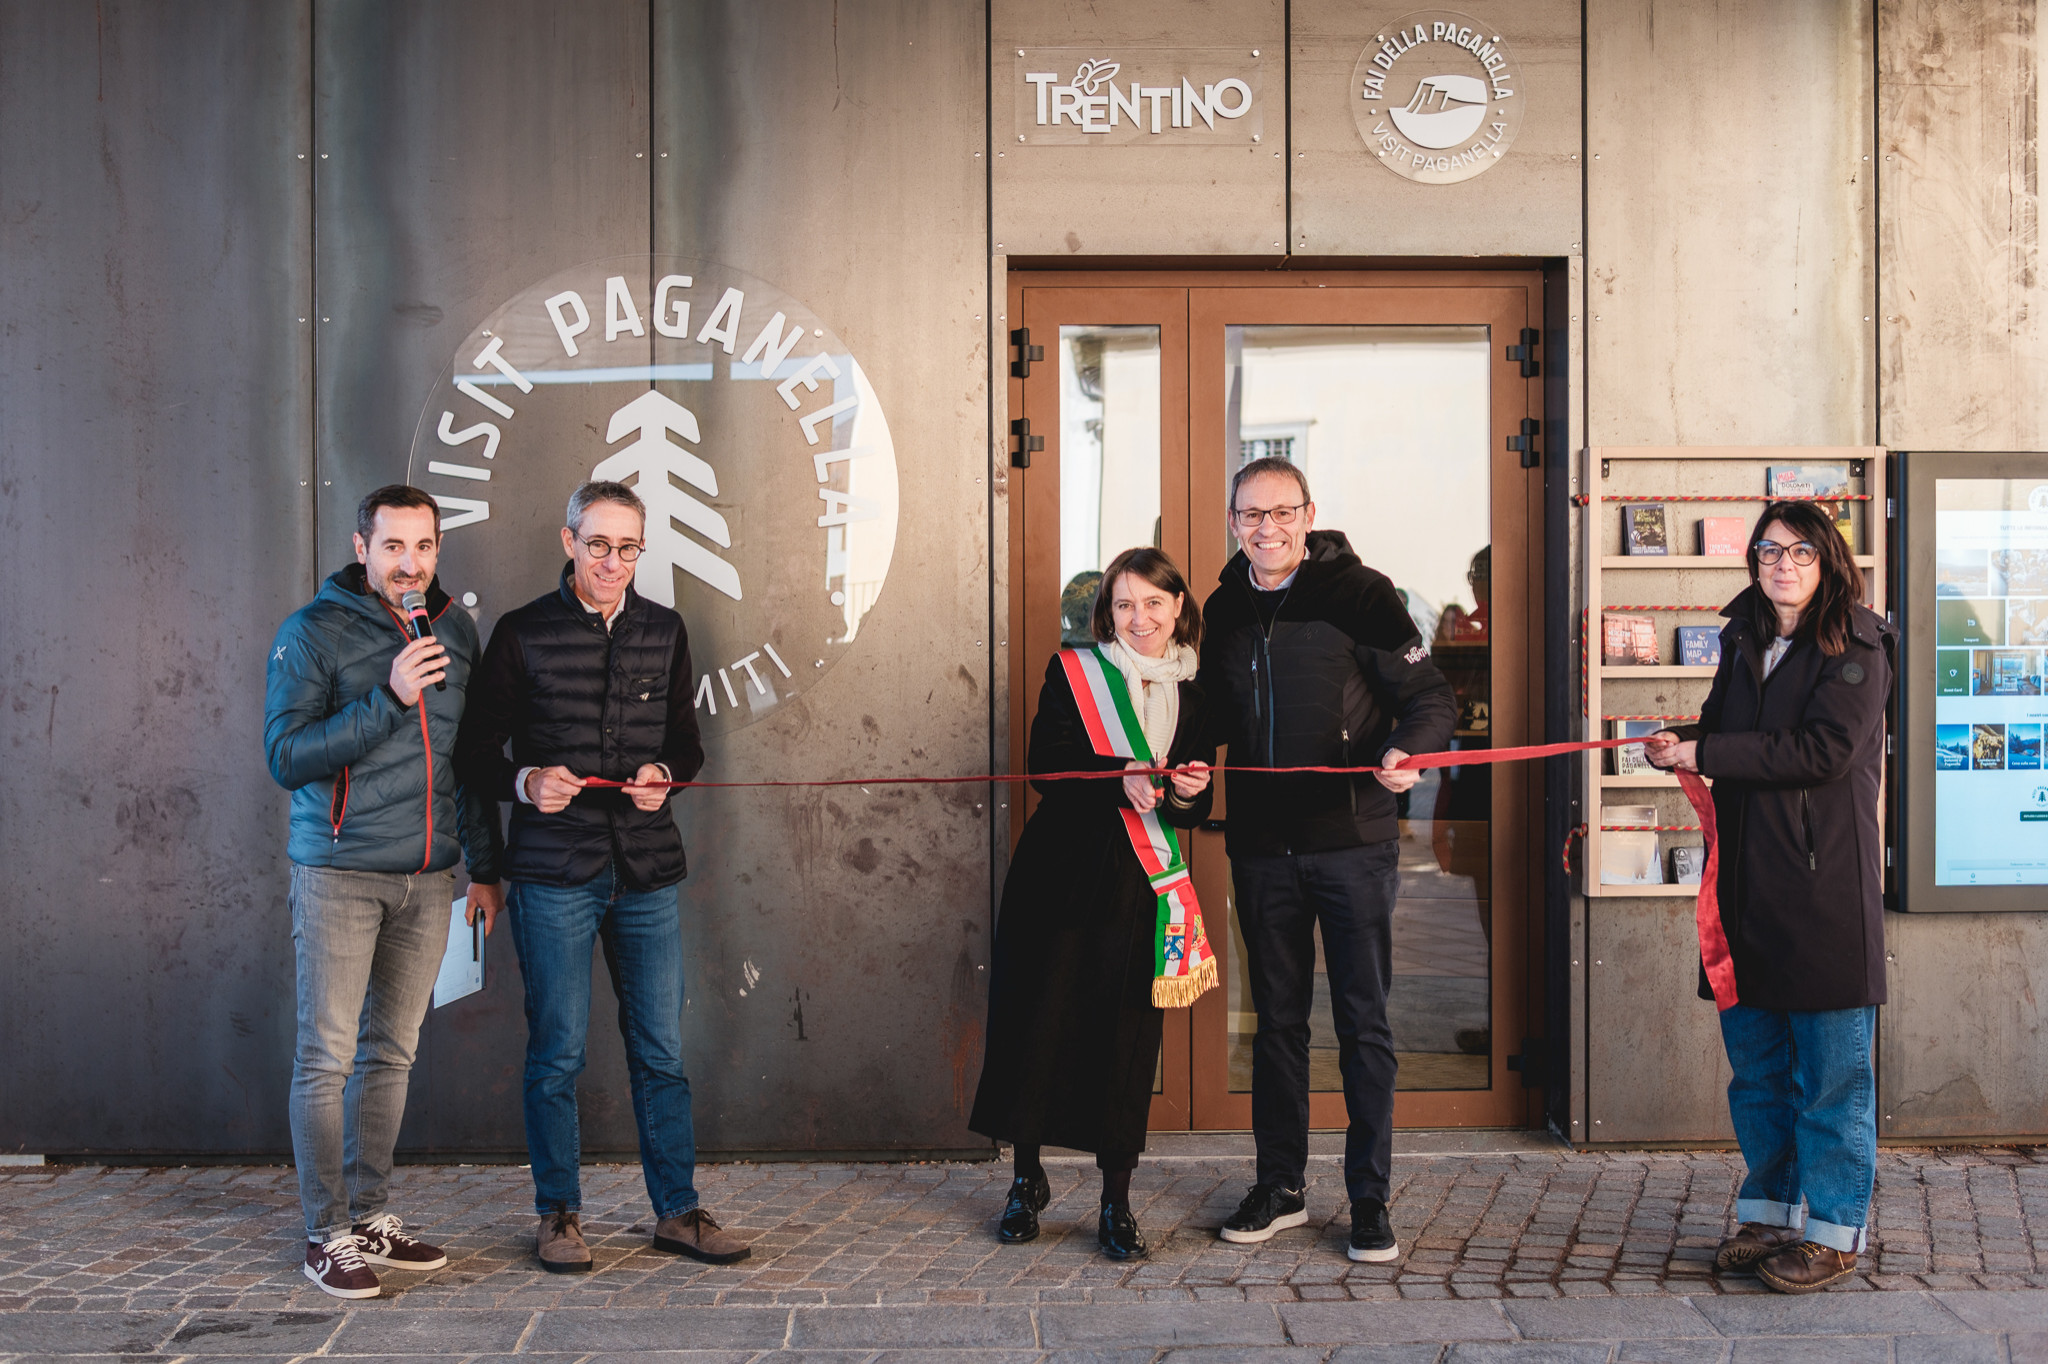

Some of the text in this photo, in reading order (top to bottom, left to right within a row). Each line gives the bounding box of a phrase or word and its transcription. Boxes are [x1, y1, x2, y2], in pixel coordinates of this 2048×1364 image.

[1363, 21, 1514, 101] FAI DELLA PAGANELLA
[1025, 72, 1253, 134] TRENTINO
[1372, 121, 1508, 172] VISIT PAGANELLA
[428, 274, 881, 532] VISIT PAGANELLA
[1685, 640, 1709, 649] FAMILY
[1686, 649, 1702, 658] MAP
